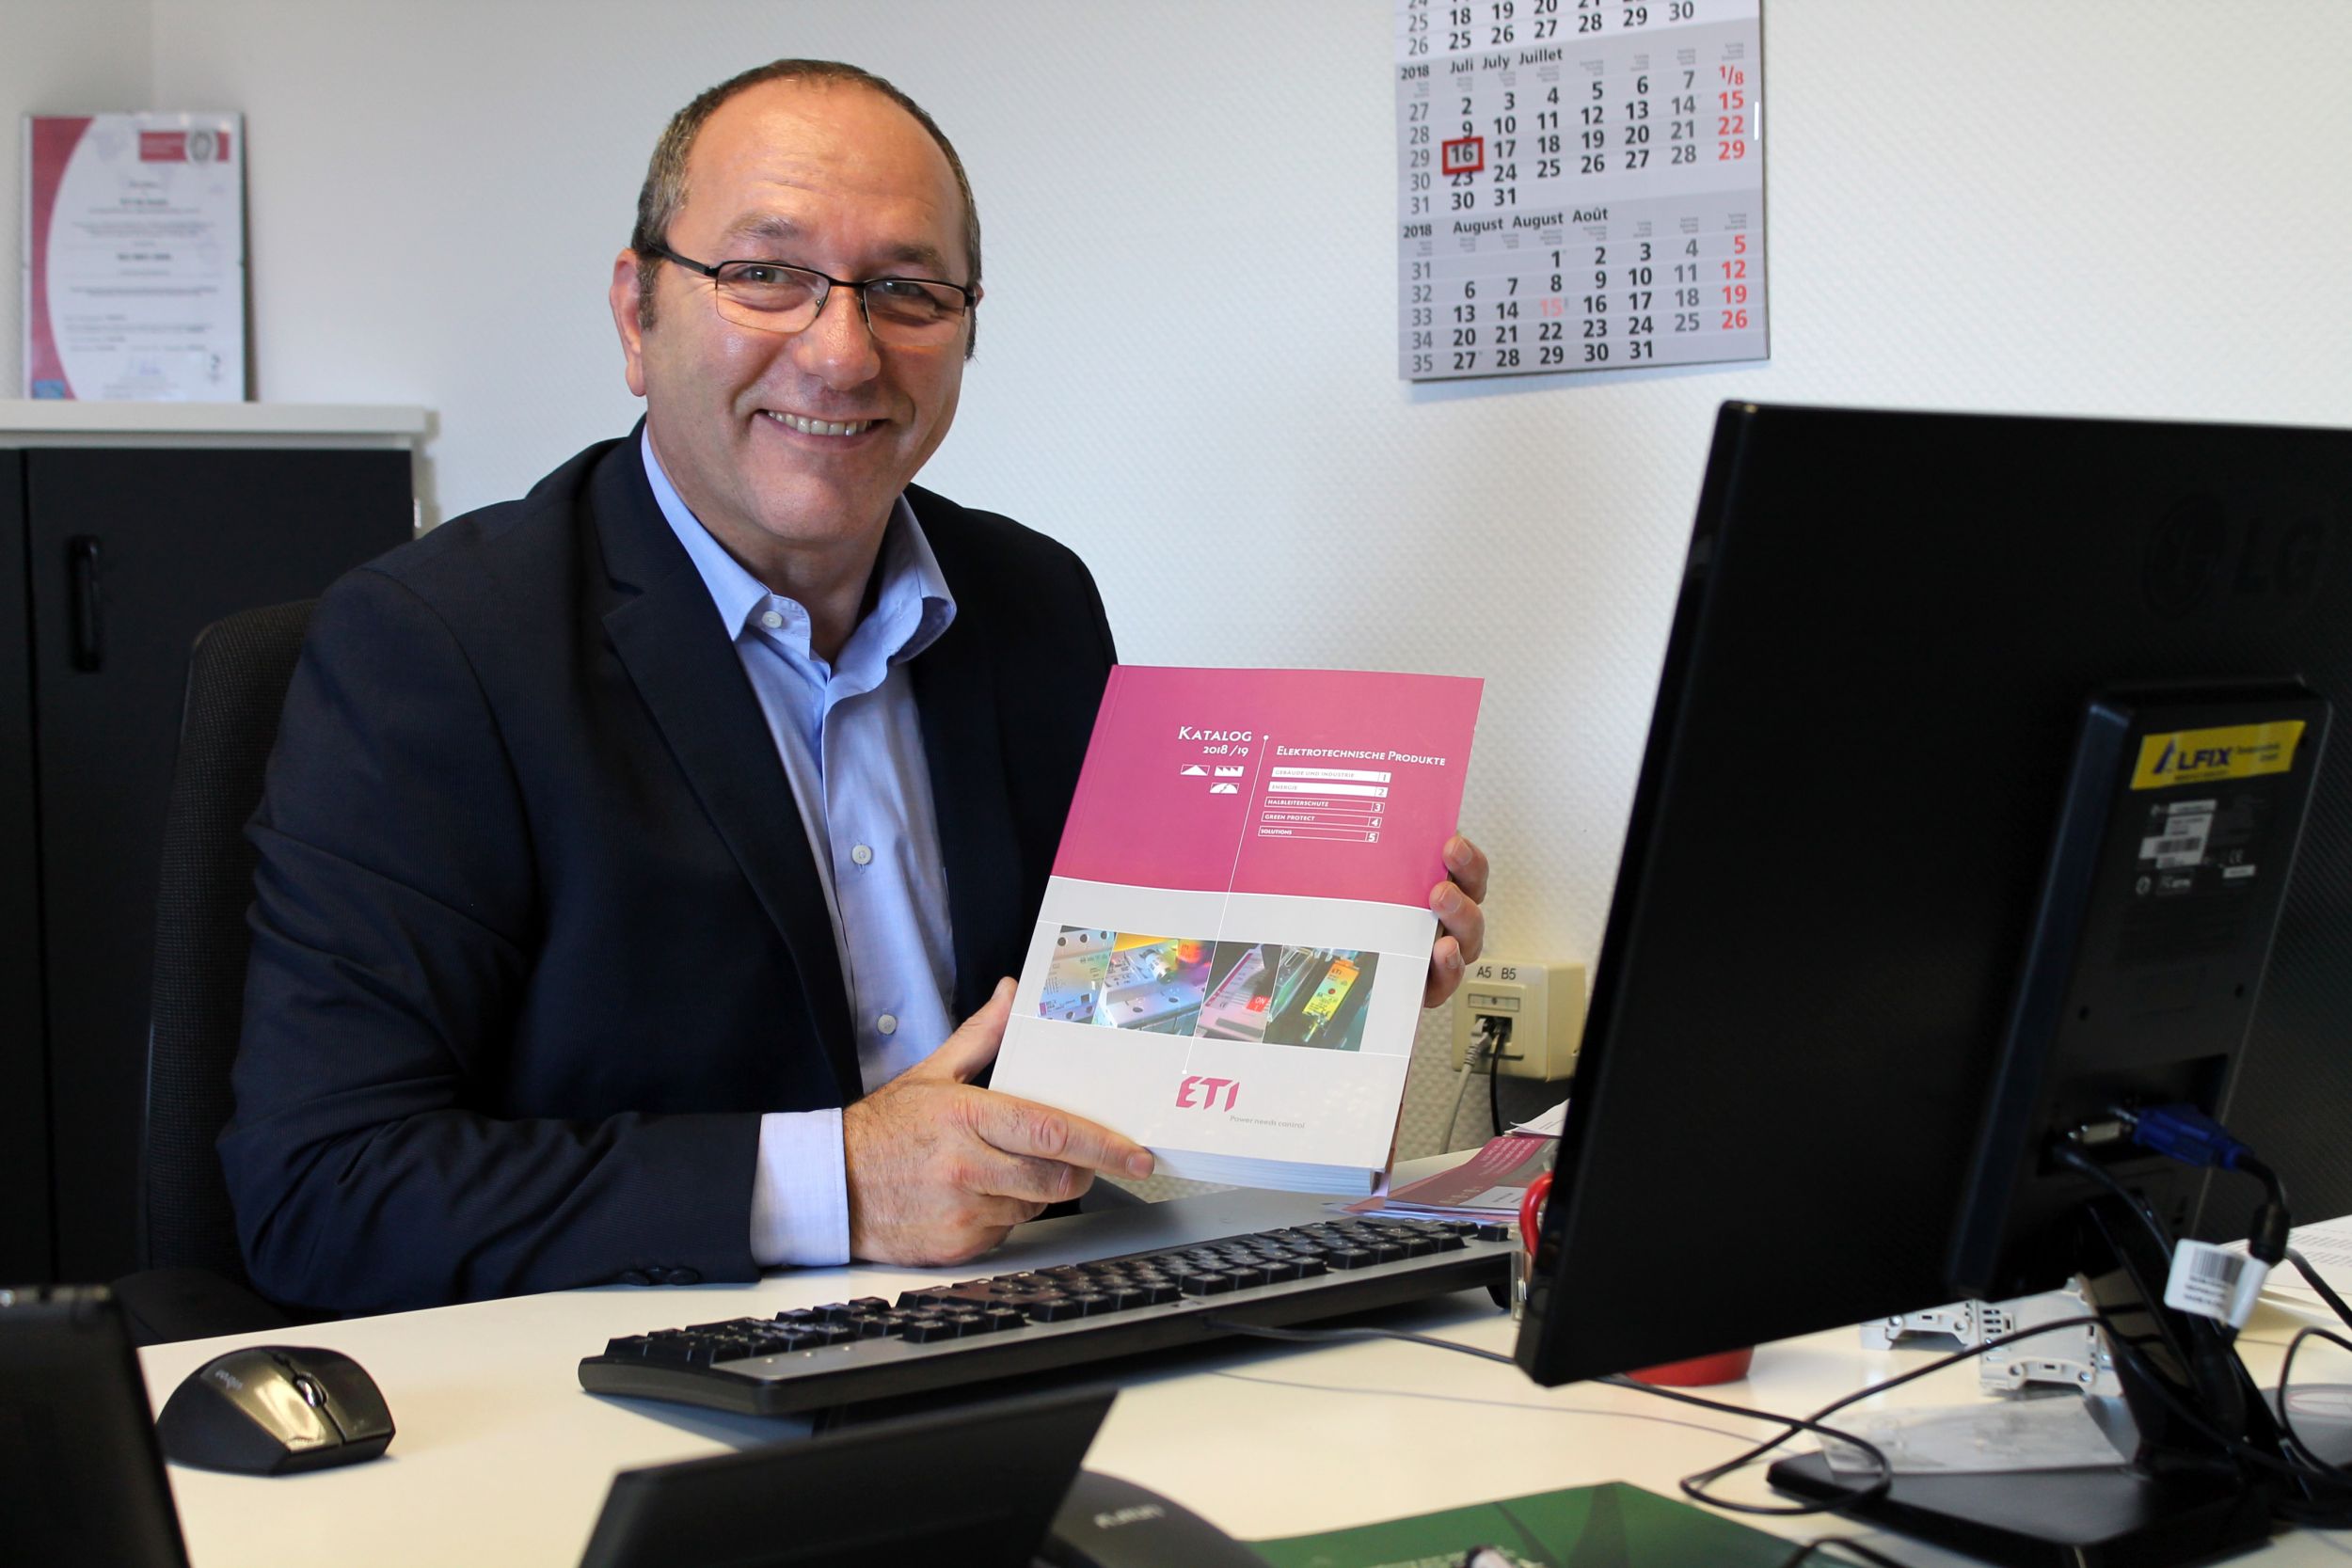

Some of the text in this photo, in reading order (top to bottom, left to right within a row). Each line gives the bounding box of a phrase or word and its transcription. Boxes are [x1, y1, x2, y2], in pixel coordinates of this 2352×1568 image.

[1408, 13, 1428, 32] 25
[1450, 8, 1470, 25] 18
[1492, 2, 1514, 20] 19
[1534, 0, 1557, 14] 20
[1408, 1, 1693, 55] 26 25 26 27 28 29 30
[1401, 49, 1563, 80] 2018 Juli July Juillet
[1409, 65, 1744, 121] 27 2 3 4 5 6 7 1/8
[1409, 90, 1744, 144] 28 9 10 11 12 13 14 15
[1410, 116, 1744, 167] 29 16 17 18 19 20 21 22
[1410, 140, 1745, 191] 30 23 24 25 26 27 28 29
[1411, 187, 1516, 214] 31 30 31
[1404, 207, 1608, 238] 2018 August August Août
[1411, 234, 1746, 280] 31 1 2 3 4 5
[1412, 260, 1746, 303] 32 6 7 8 9 10 11 12
[1412, 284, 1747, 326] 33 13 14 15 16 17 18 19
[1412, 309, 1747, 350] 34 20 21 22 23 24 25 26
[1413, 341, 1653, 372] 35 27 28 29 30 31
[1202, 744, 1229, 754] 2018
[1321, 769, 1355, 779] INDUSTRIE
[1267, 799, 1381, 812] HALBLEITERSCHUTZ 3
[1271, 783, 1385, 797] ENERGIE 2
[1368, 832, 1376, 843] 5
[1371, 818, 1379, 827] 4
[1476, 966, 1517, 980] A5 B5
[1176, 1075, 1240, 1112] ETI
[1230, 1115, 1305, 1130] Power needs control
